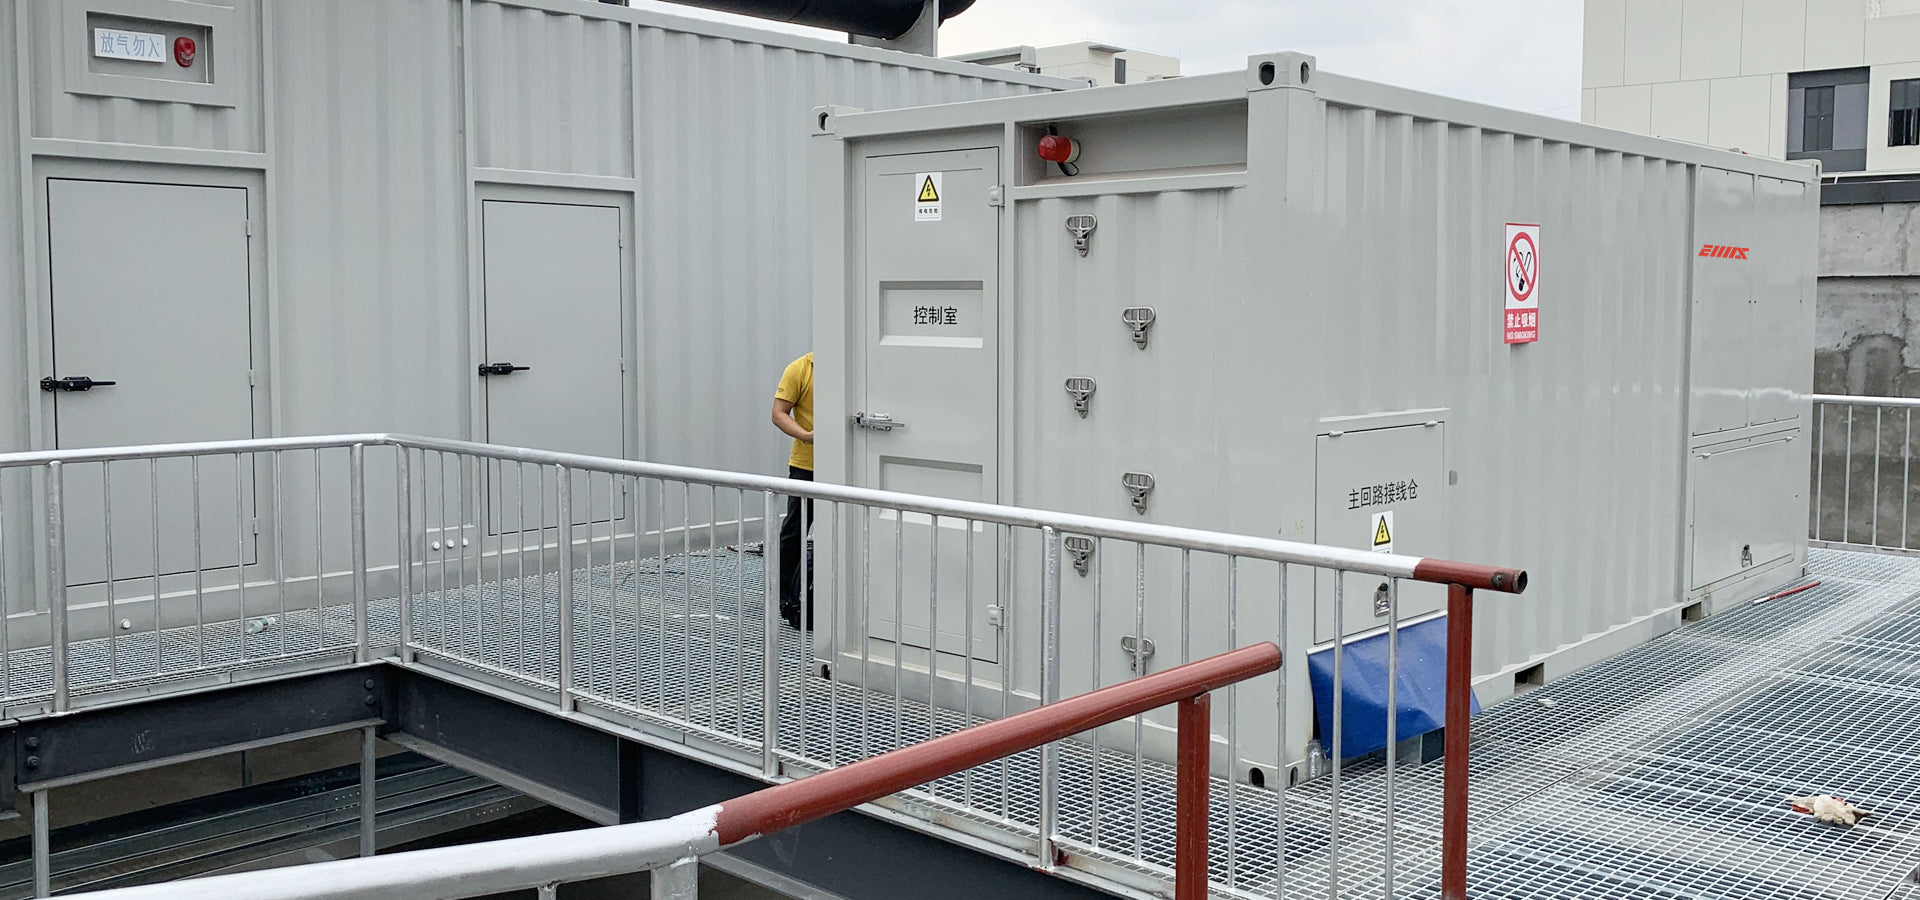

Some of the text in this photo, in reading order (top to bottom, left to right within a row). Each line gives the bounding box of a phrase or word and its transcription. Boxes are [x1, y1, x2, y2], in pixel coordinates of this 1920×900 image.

[100, 32, 160, 58] 放气勿入
[913, 305, 958, 325] 控制室
[1506, 312, 1537, 328] 禁止吸烟
[1506, 330, 1536, 340] NO SMOKING
[1348, 478, 1418, 510] 主回路接线仓
